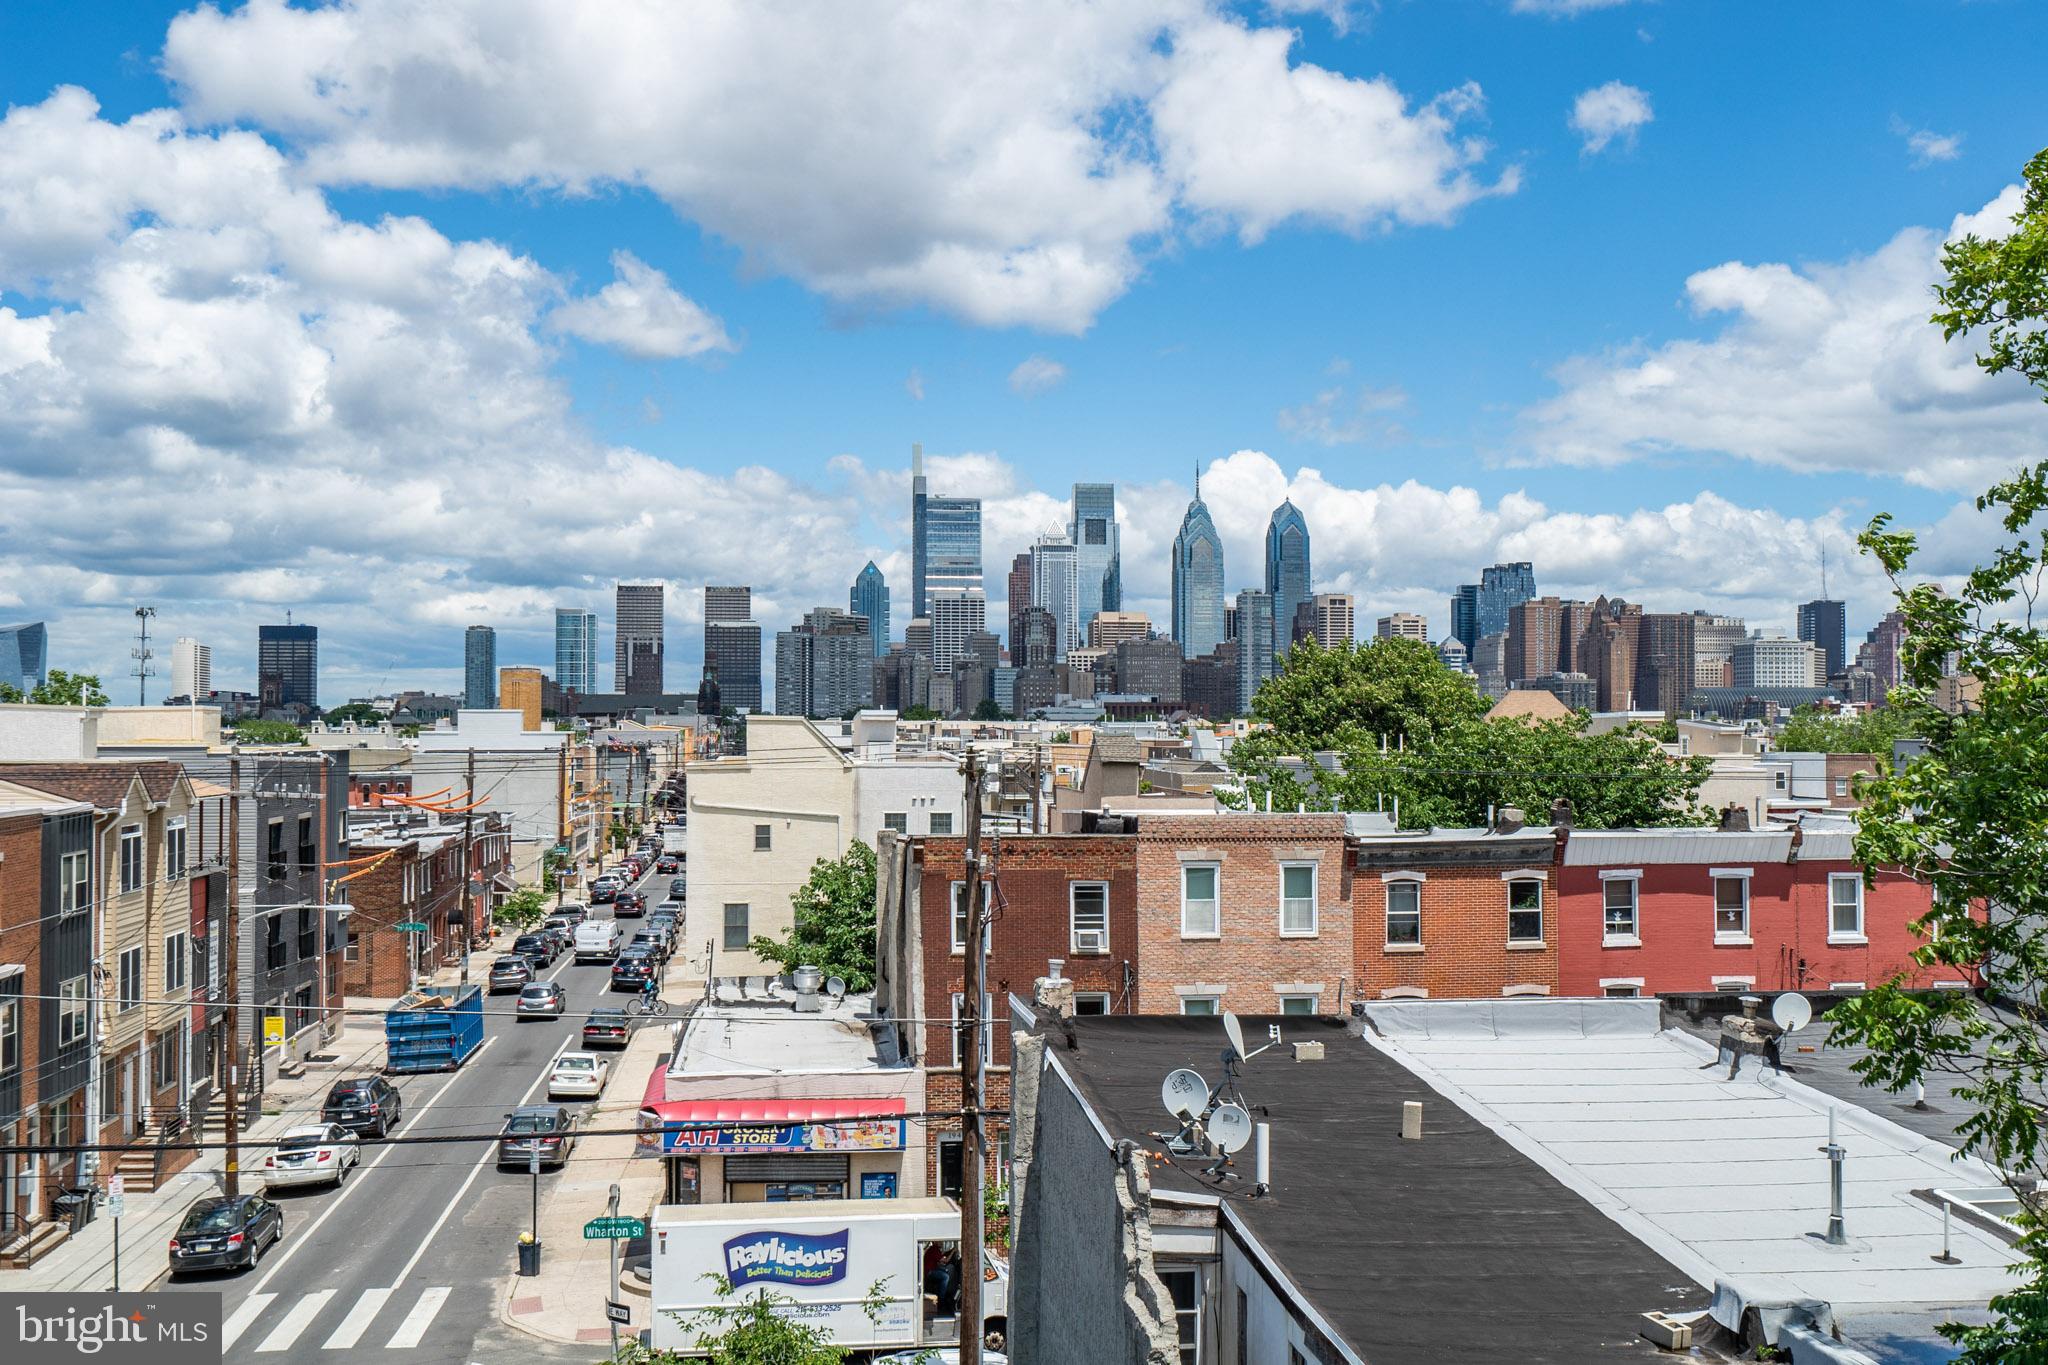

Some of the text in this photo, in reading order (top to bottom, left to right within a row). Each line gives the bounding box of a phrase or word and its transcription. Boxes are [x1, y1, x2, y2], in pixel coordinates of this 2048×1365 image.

[674, 1122, 721, 1146] AH
[732, 1133, 778, 1144] STORE
[586, 1226, 642, 1238] Wharton St
[729, 1237, 843, 1272] Raylicious
[746, 1266, 833, 1279] Better Than Delicious!
